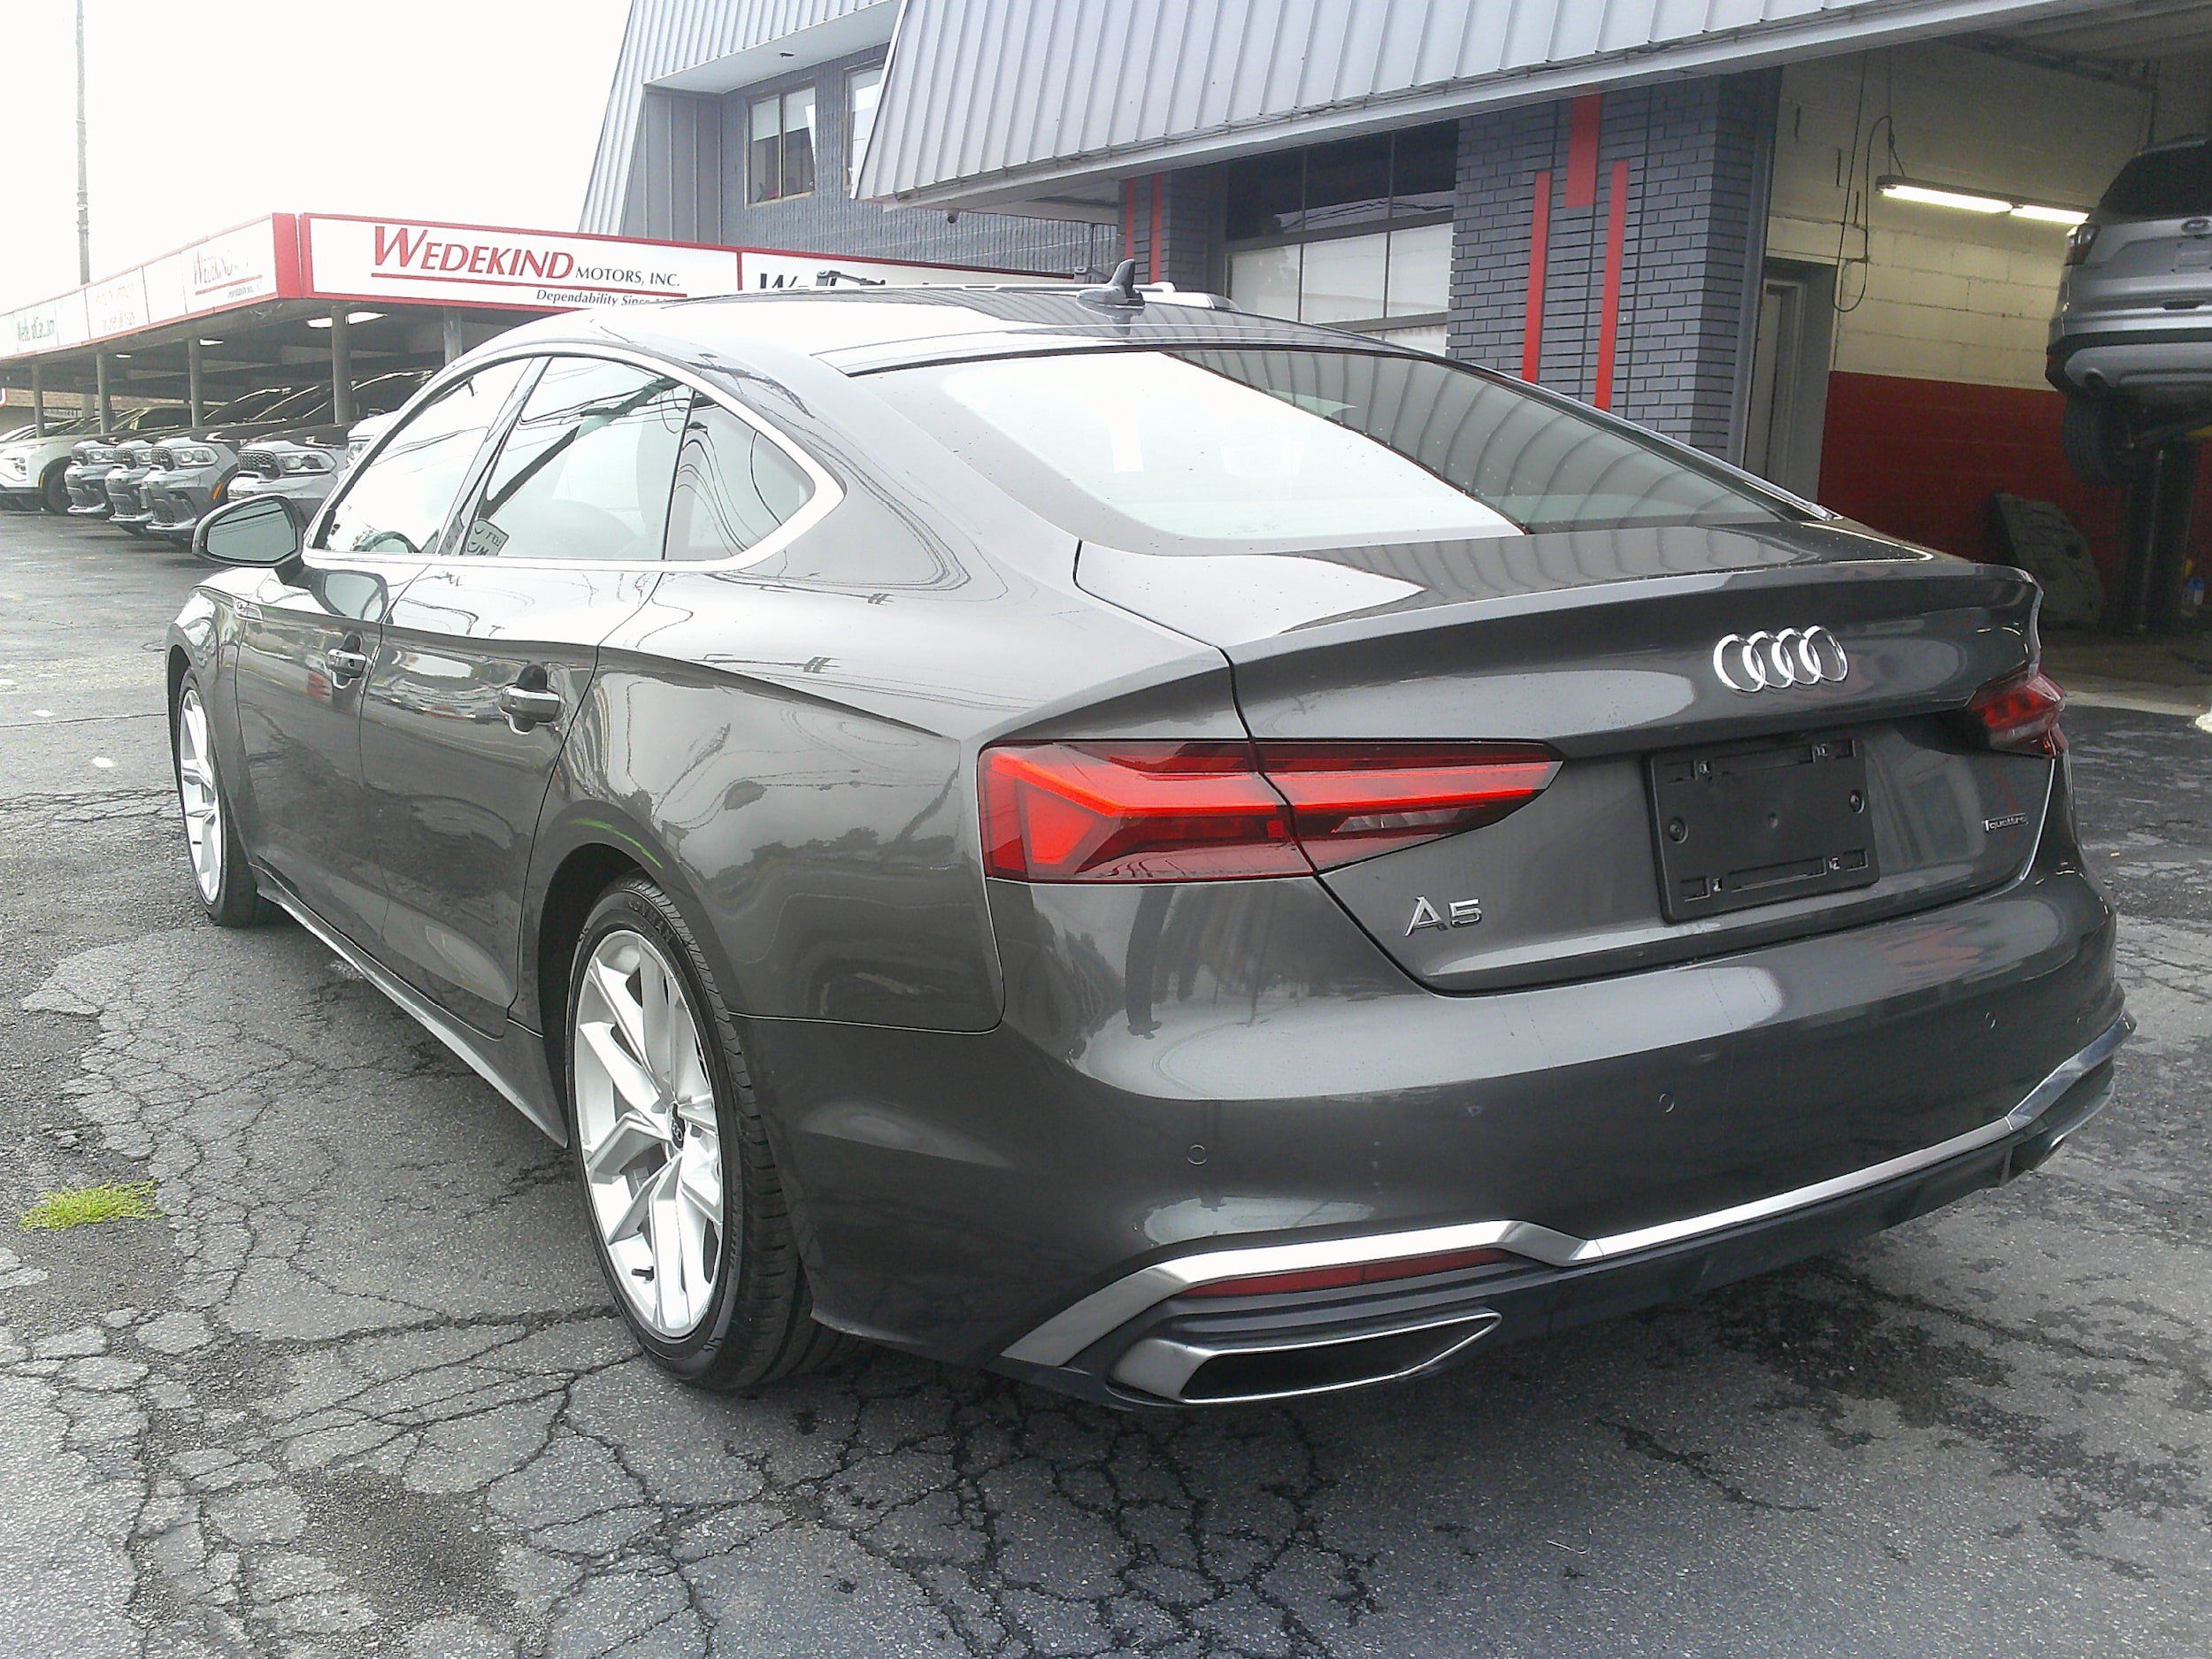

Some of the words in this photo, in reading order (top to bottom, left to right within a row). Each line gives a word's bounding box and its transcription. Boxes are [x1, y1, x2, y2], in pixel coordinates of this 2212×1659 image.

[375, 227, 574, 279] WEDEKIND
[575, 267, 645, 286] MOTORS,
[649, 273, 680, 287] INC.
[536, 289, 618, 307] Dependability
[1403, 895, 1483, 937] A5
